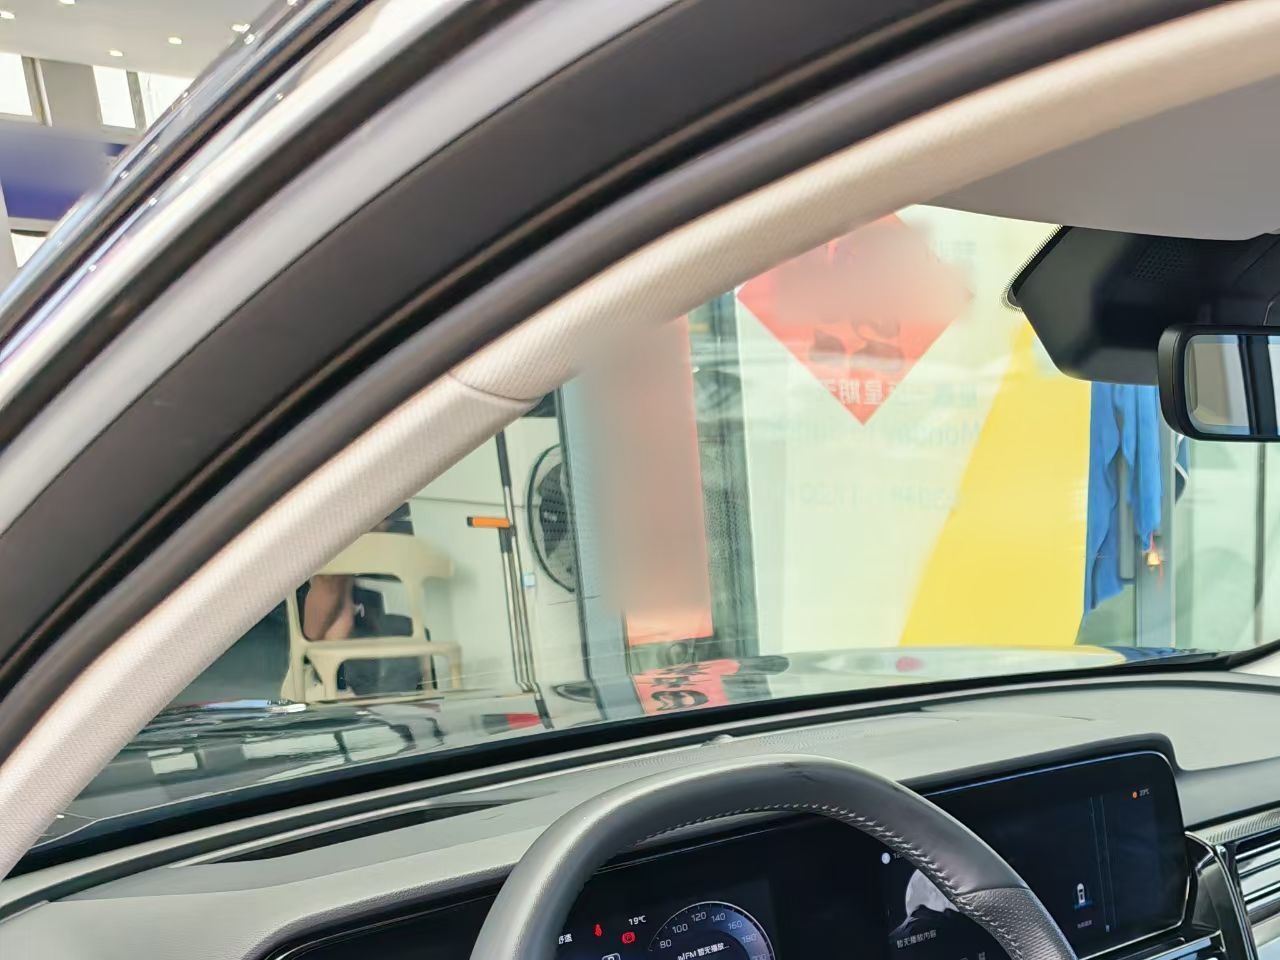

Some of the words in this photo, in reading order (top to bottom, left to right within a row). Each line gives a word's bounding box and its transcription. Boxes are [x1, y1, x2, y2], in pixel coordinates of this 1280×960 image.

[691, 911, 707, 922] 120
[711, 912, 726, 923] 140
[672, 923, 689, 934] 100
[660, 939, 672, 949] 80
